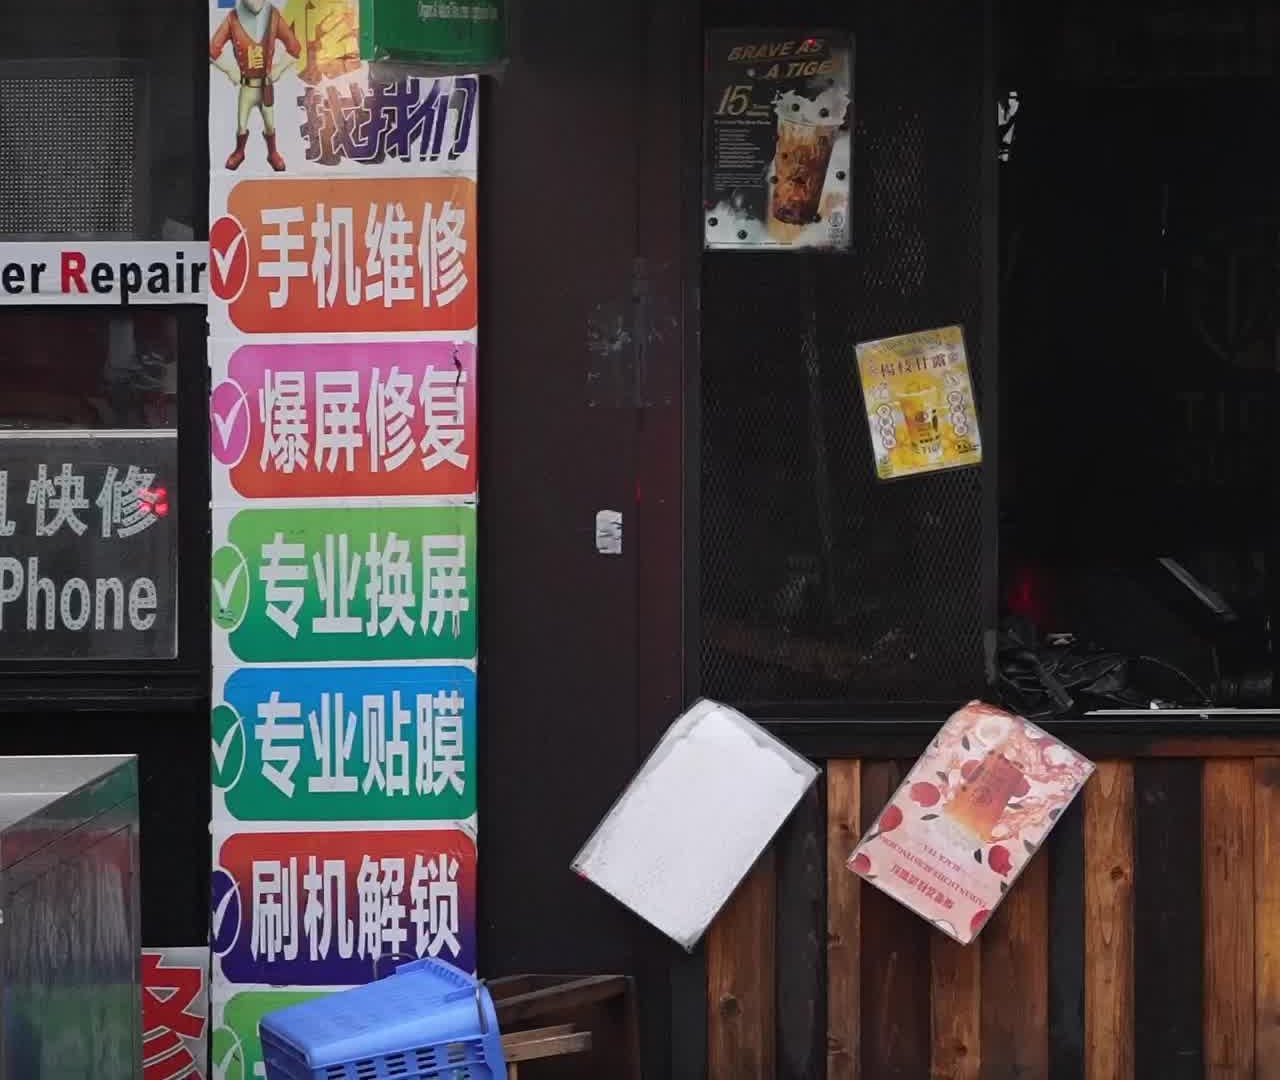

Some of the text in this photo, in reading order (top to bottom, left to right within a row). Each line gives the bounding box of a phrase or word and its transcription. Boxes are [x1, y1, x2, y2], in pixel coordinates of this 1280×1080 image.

[727, 41, 794, 61] BRAVE
[785, 58, 838, 79] TIGE
[713, 84, 753, 118] 15
[1, 251, 206, 307] er Repair
[258, 201, 470, 309] 手机维修
[258, 365, 470, 473] 爆屏修复
[0, 556, 158, 631] Phone
[258, 532, 470, 640] 专业换屏
[254, 690, 466, 799] 专业贴膜
[250, 853, 462, 962] 刷机解锁
